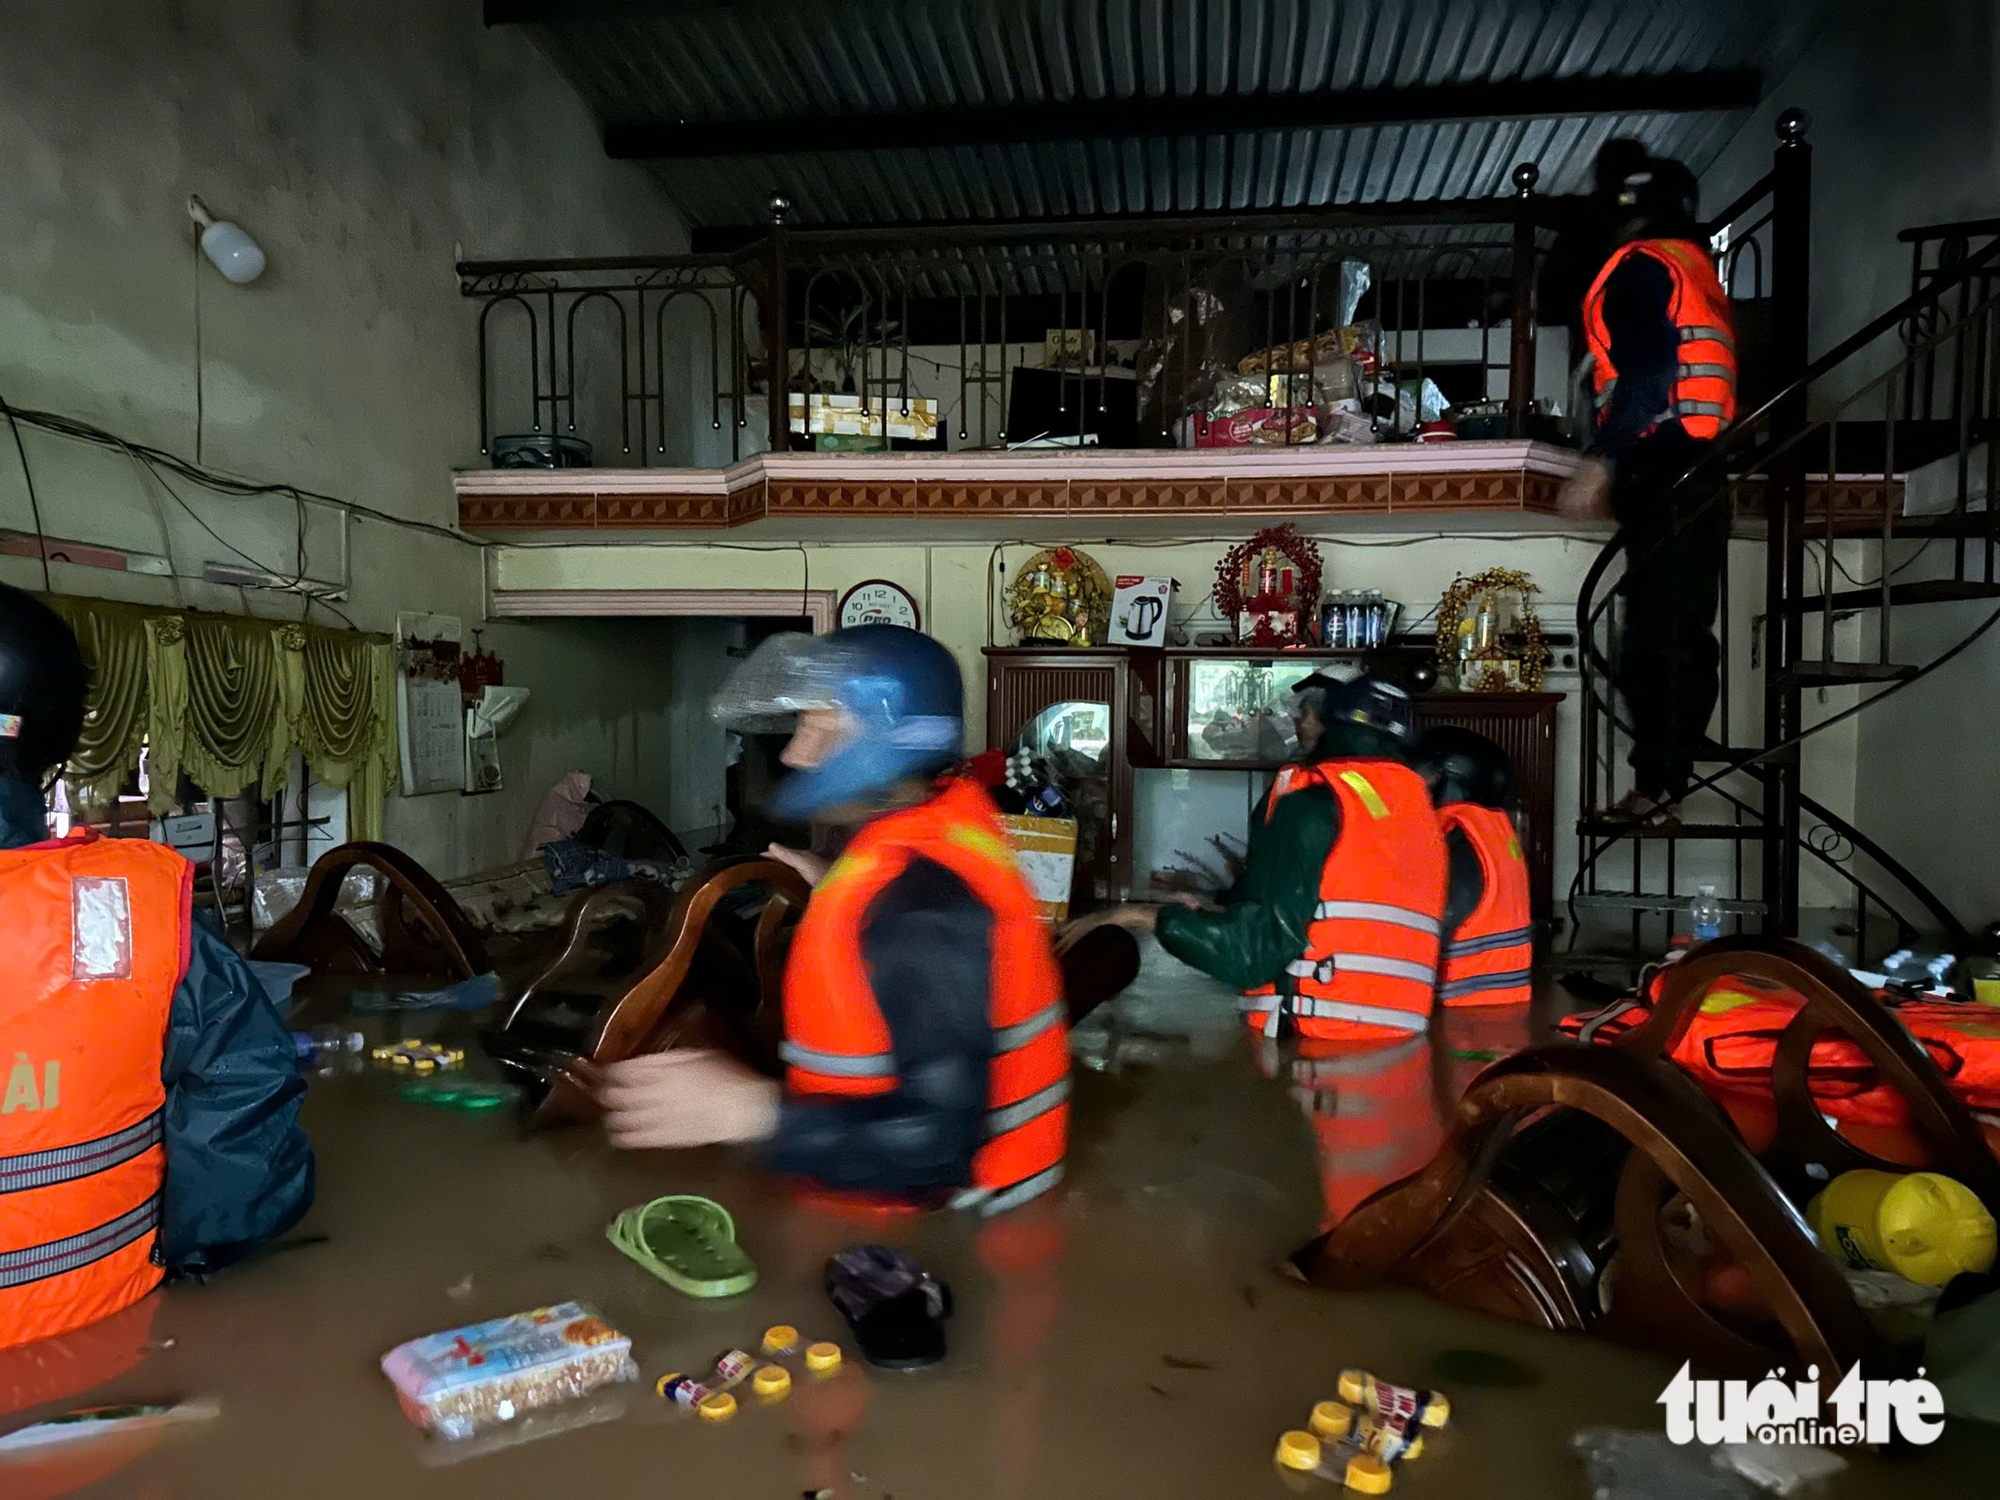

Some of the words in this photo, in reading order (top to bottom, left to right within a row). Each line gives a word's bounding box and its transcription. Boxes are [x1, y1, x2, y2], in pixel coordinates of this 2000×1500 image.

[862, 592, 871, 601] 11
[874, 589, 887, 599] 12
[851, 602, 863, 611] 10
[898, 606, 908, 616] 2
[847, 615, 856, 624] 9
